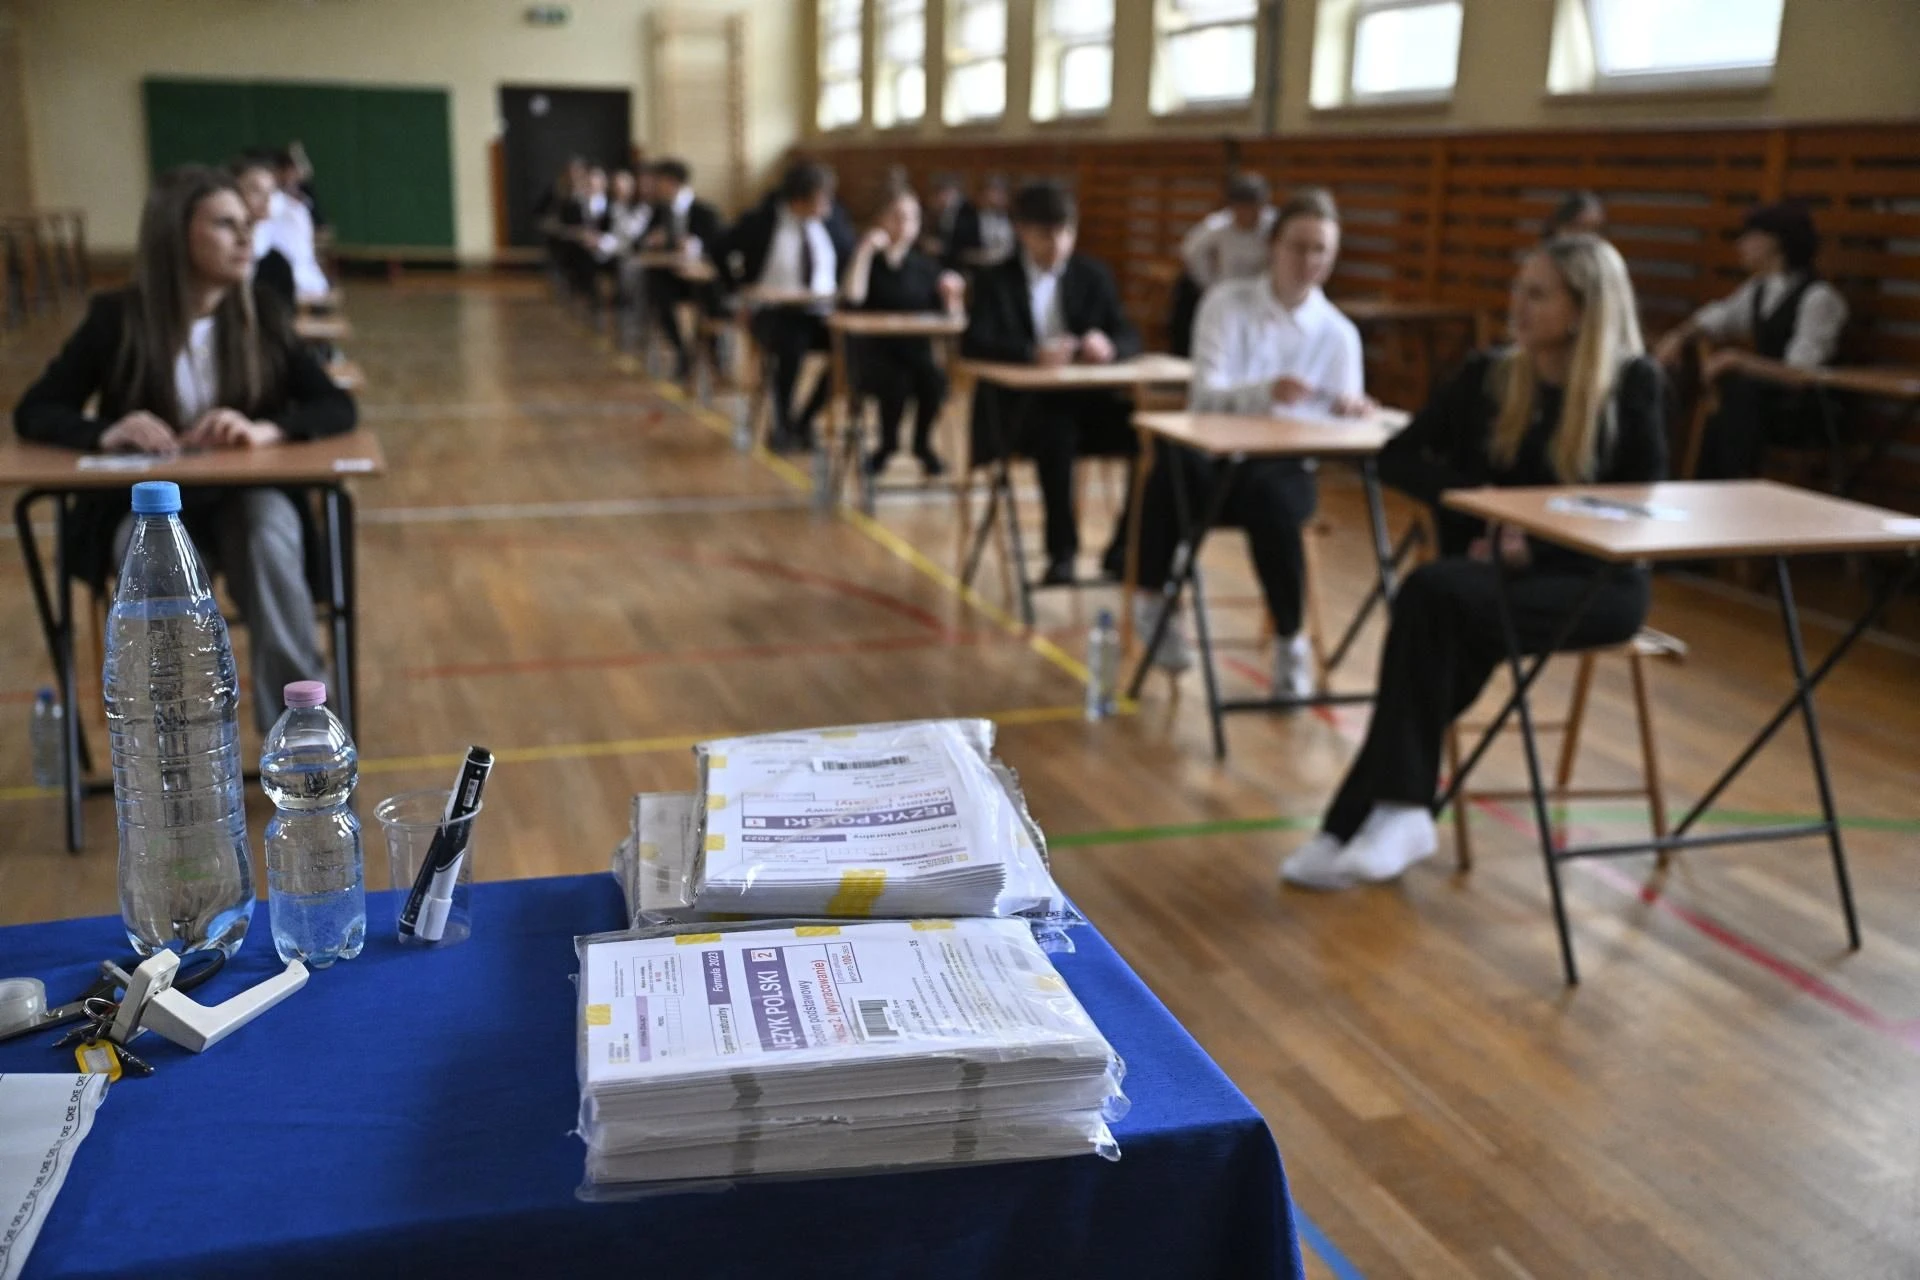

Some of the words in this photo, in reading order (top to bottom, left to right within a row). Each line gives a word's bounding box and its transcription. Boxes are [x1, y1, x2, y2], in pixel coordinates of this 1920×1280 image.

[784, 814, 871, 826] POLSKI
[879, 803, 953, 825] JĘZYK
[708, 951, 720, 967] 2023
[712, 967, 724, 992] Formuła
[811, 959, 841, 1016] (wypracowanie)
[757, 970, 789, 1015] POLSKI
[799, 979, 820, 1024] podstawowy
[717, 1007, 731, 1034] maturalny
[765, 1014, 798, 1049] JĘZYK
[76, 1075, 87, 1087] CKE
[70, 1089, 82, 1102] CKE
[66, 1105, 77, 1122] CKE
